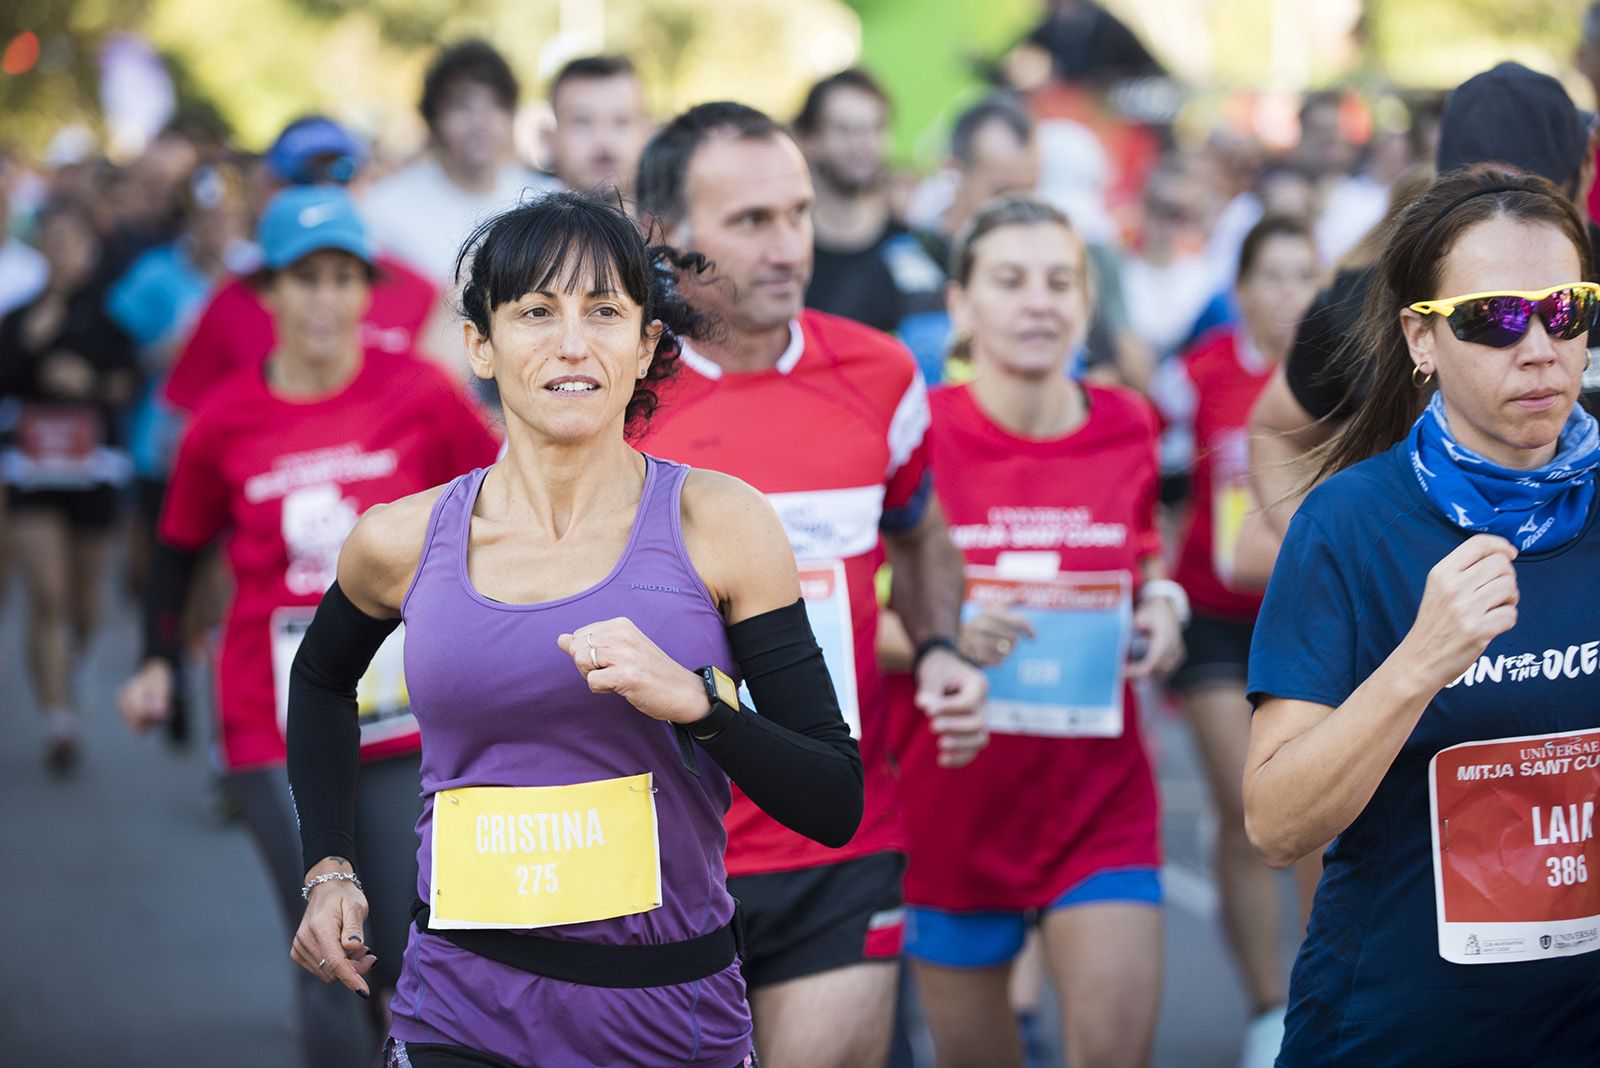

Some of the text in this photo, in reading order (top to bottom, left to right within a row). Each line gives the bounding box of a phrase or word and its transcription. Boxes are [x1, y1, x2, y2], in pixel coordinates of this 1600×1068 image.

[631, 583, 680, 593] PROTON
[1504, 653, 1544, 669] FOR
[1508, 665, 1541, 682] THE
[1520, 740, 1599, 760] UNIVERSAE
[1457, 763, 1514, 780] MITJA
[1520, 758, 1572, 776] SANT
[475, 808, 605, 854] CRISTINA
[516, 864, 558, 895] 275
[1546, 854, 1588, 887] 386
